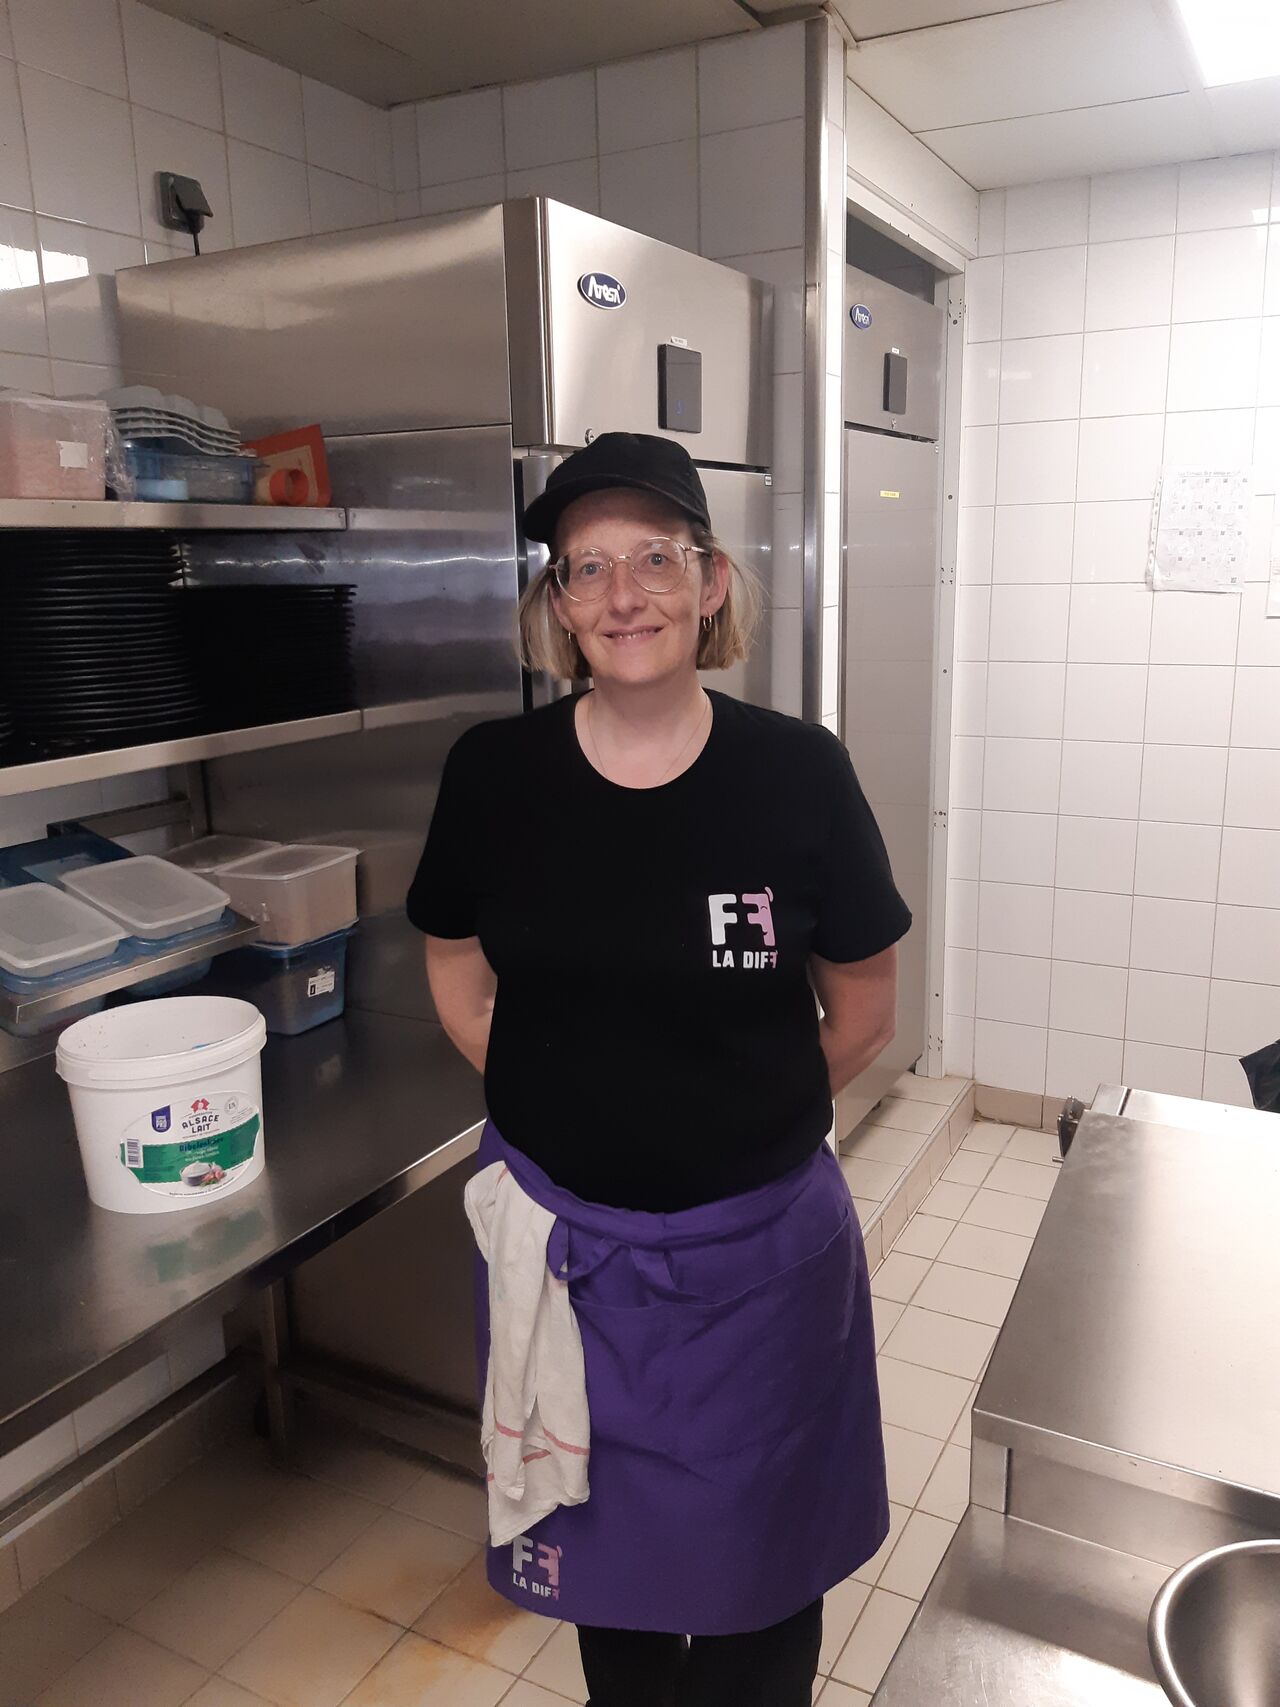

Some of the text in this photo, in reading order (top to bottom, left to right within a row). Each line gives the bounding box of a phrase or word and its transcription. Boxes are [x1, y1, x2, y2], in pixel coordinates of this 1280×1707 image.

[712, 949, 735, 968] LA
[181, 1114, 220, 1129] ALSACE
[191, 1123, 211, 1134] LAIT
[512, 1572, 528, 1590] LA
